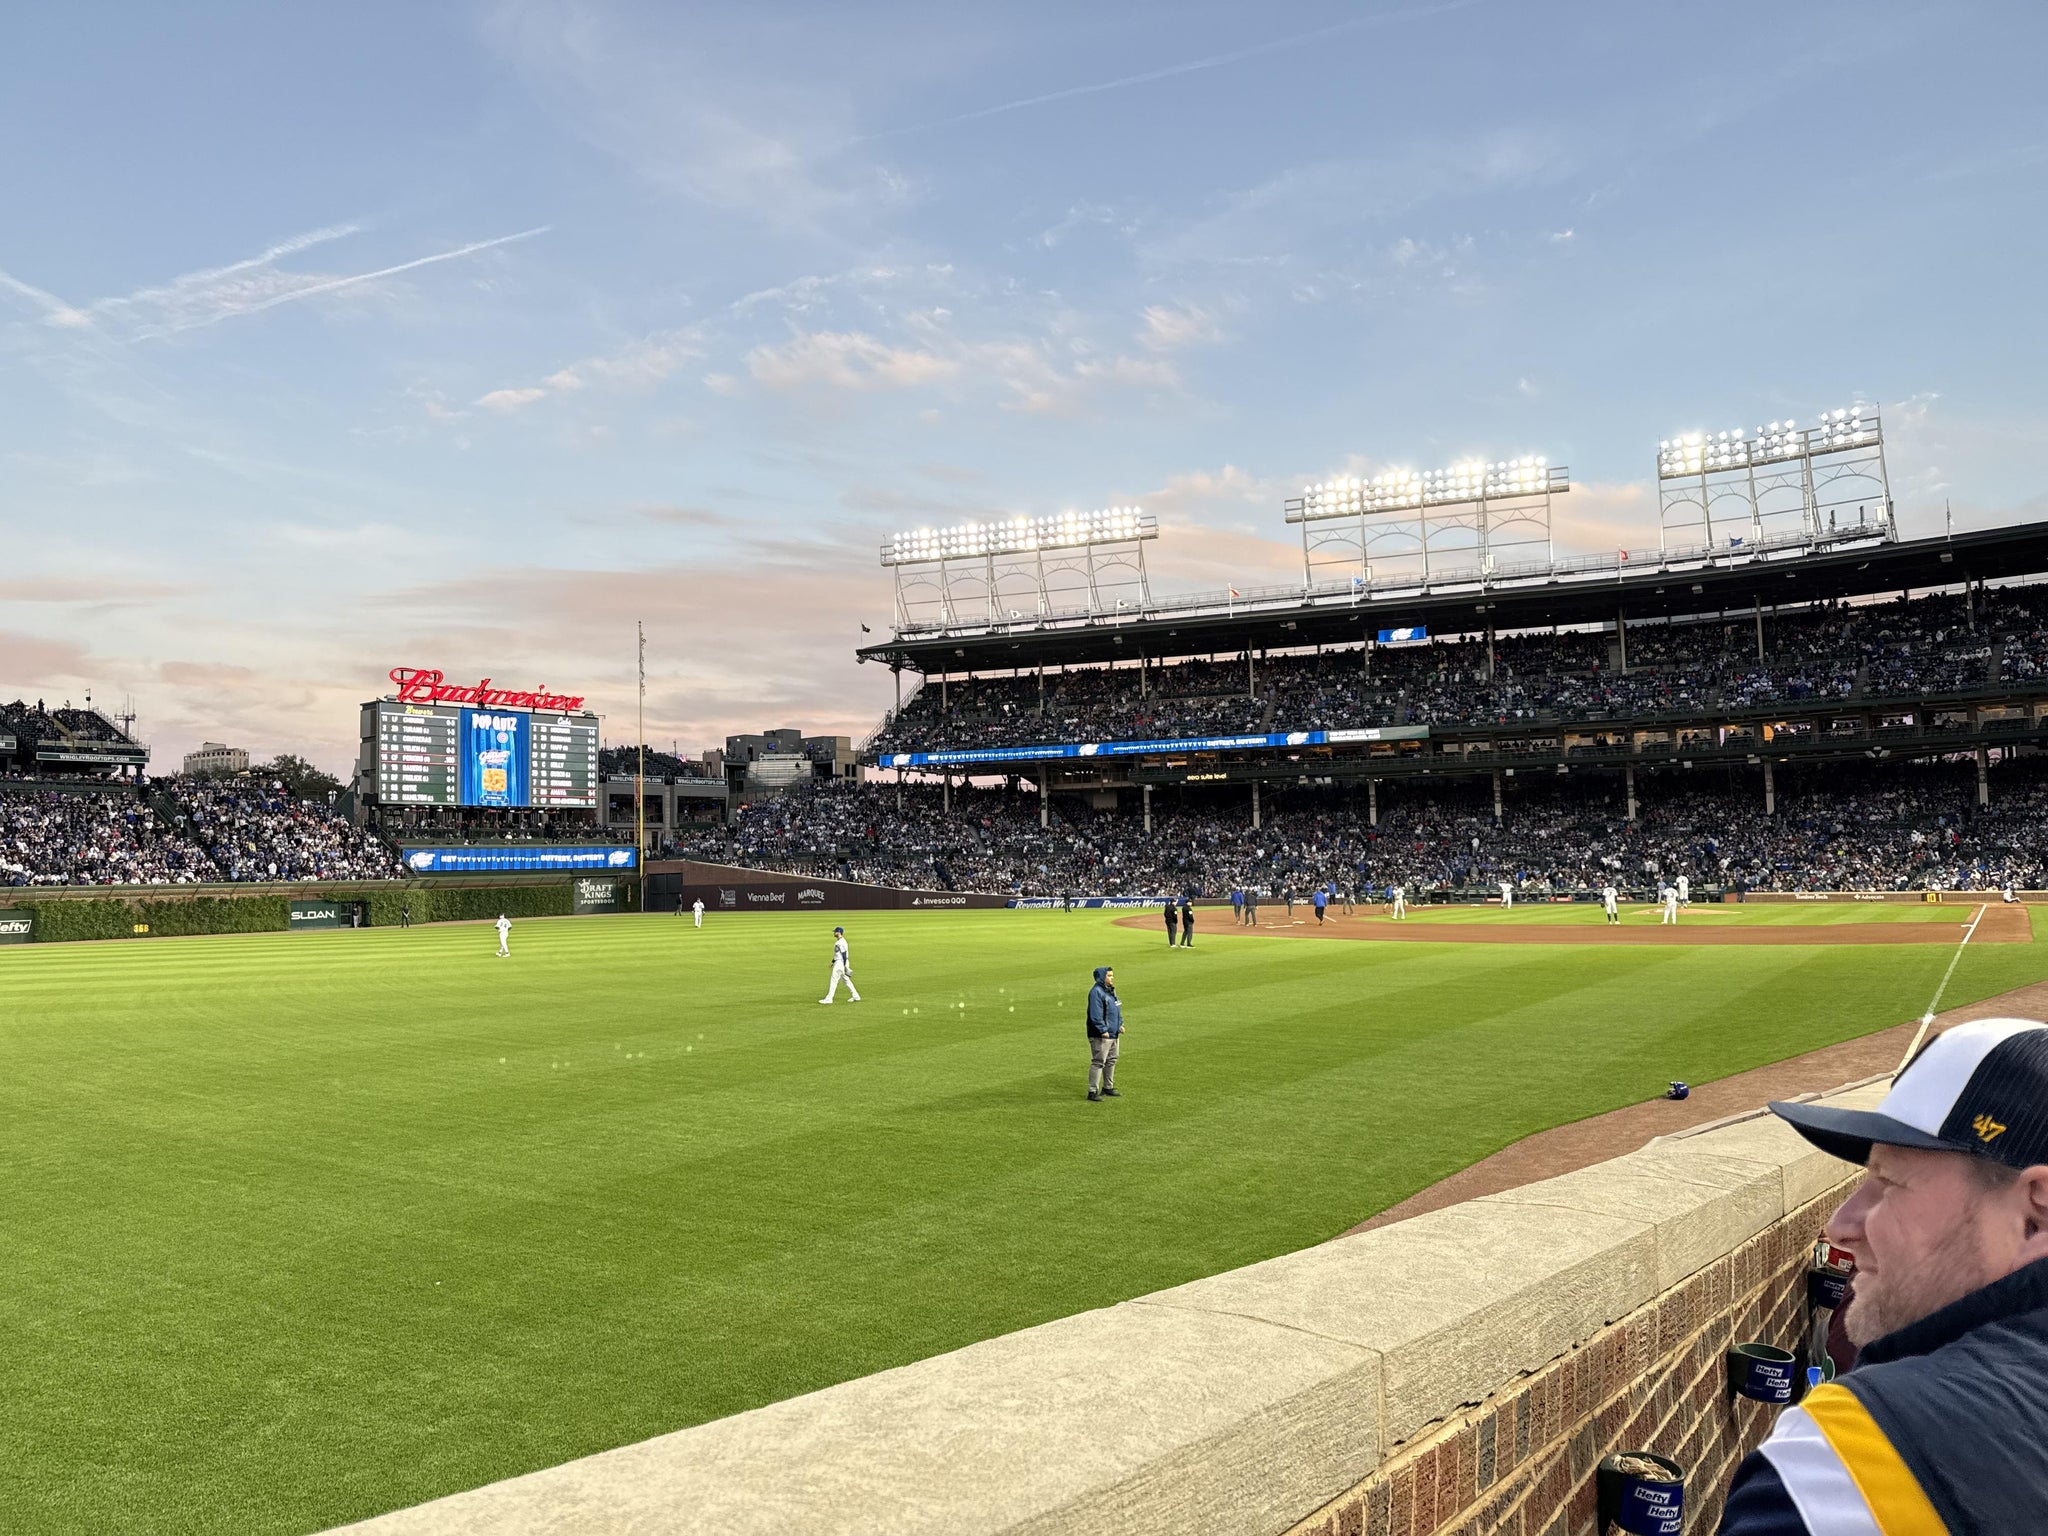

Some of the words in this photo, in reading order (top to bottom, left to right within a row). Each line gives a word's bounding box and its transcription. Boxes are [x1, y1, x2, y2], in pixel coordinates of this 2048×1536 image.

[389, 667, 584, 711] Budweiser
[472, 713, 492, 730] POP
[493, 716, 517, 731] QUIZ
[580, 884, 612, 893] DRAFT
[747, 892, 769, 902] Vienna
[770, 892, 785, 903] Beef
[797, 889, 825, 900] MARQUEE
[1015, 900, 1052, 909] Reynolds
[1053, 900, 1075, 908] Wrp
[1102, 900, 1141, 908] Reynolds
[1757, 1366, 1781, 1376] Hefty
[1636, 1488, 1669, 1503] Hefty
[1650, 1507, 1677, 1517] Hefty
[1662, 1521, 1681, 1531] Heft
